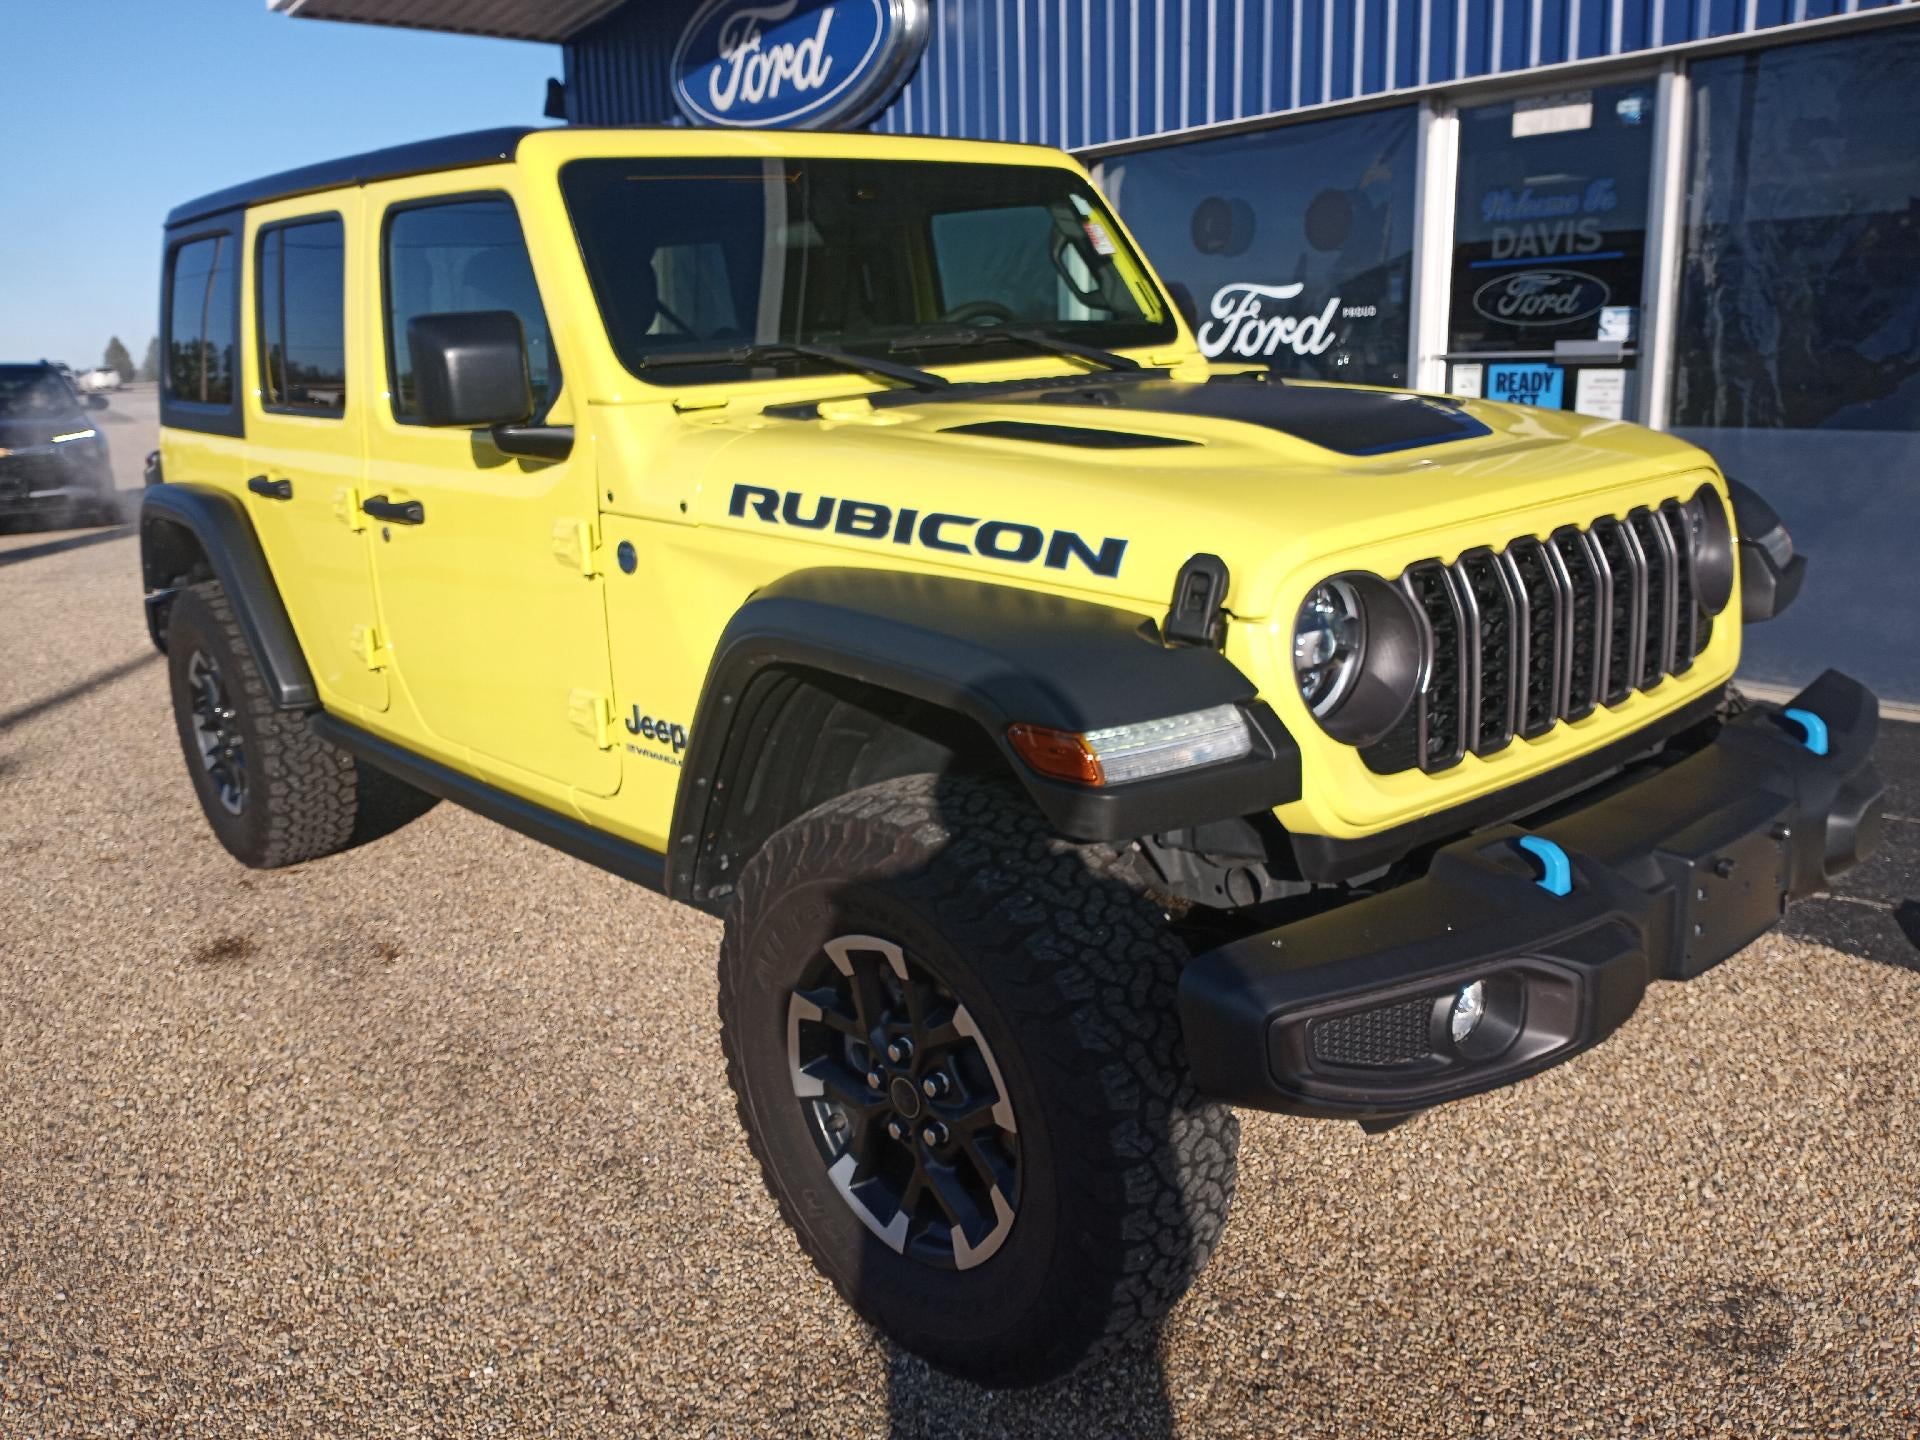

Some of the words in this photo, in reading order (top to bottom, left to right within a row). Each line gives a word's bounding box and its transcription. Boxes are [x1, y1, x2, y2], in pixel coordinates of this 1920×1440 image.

[709, 0, 834, 112] Ford
[1491, 218, 1604, 260] DAVIS
[1498, 273, 1584, 316] Ford
[1197, 282, 1341, 358] Ford
[1495, 371, 1554, 394] READY
[728, 483, 1129, 579] RUBICON
[625, 704, 687, 754] Jeep
